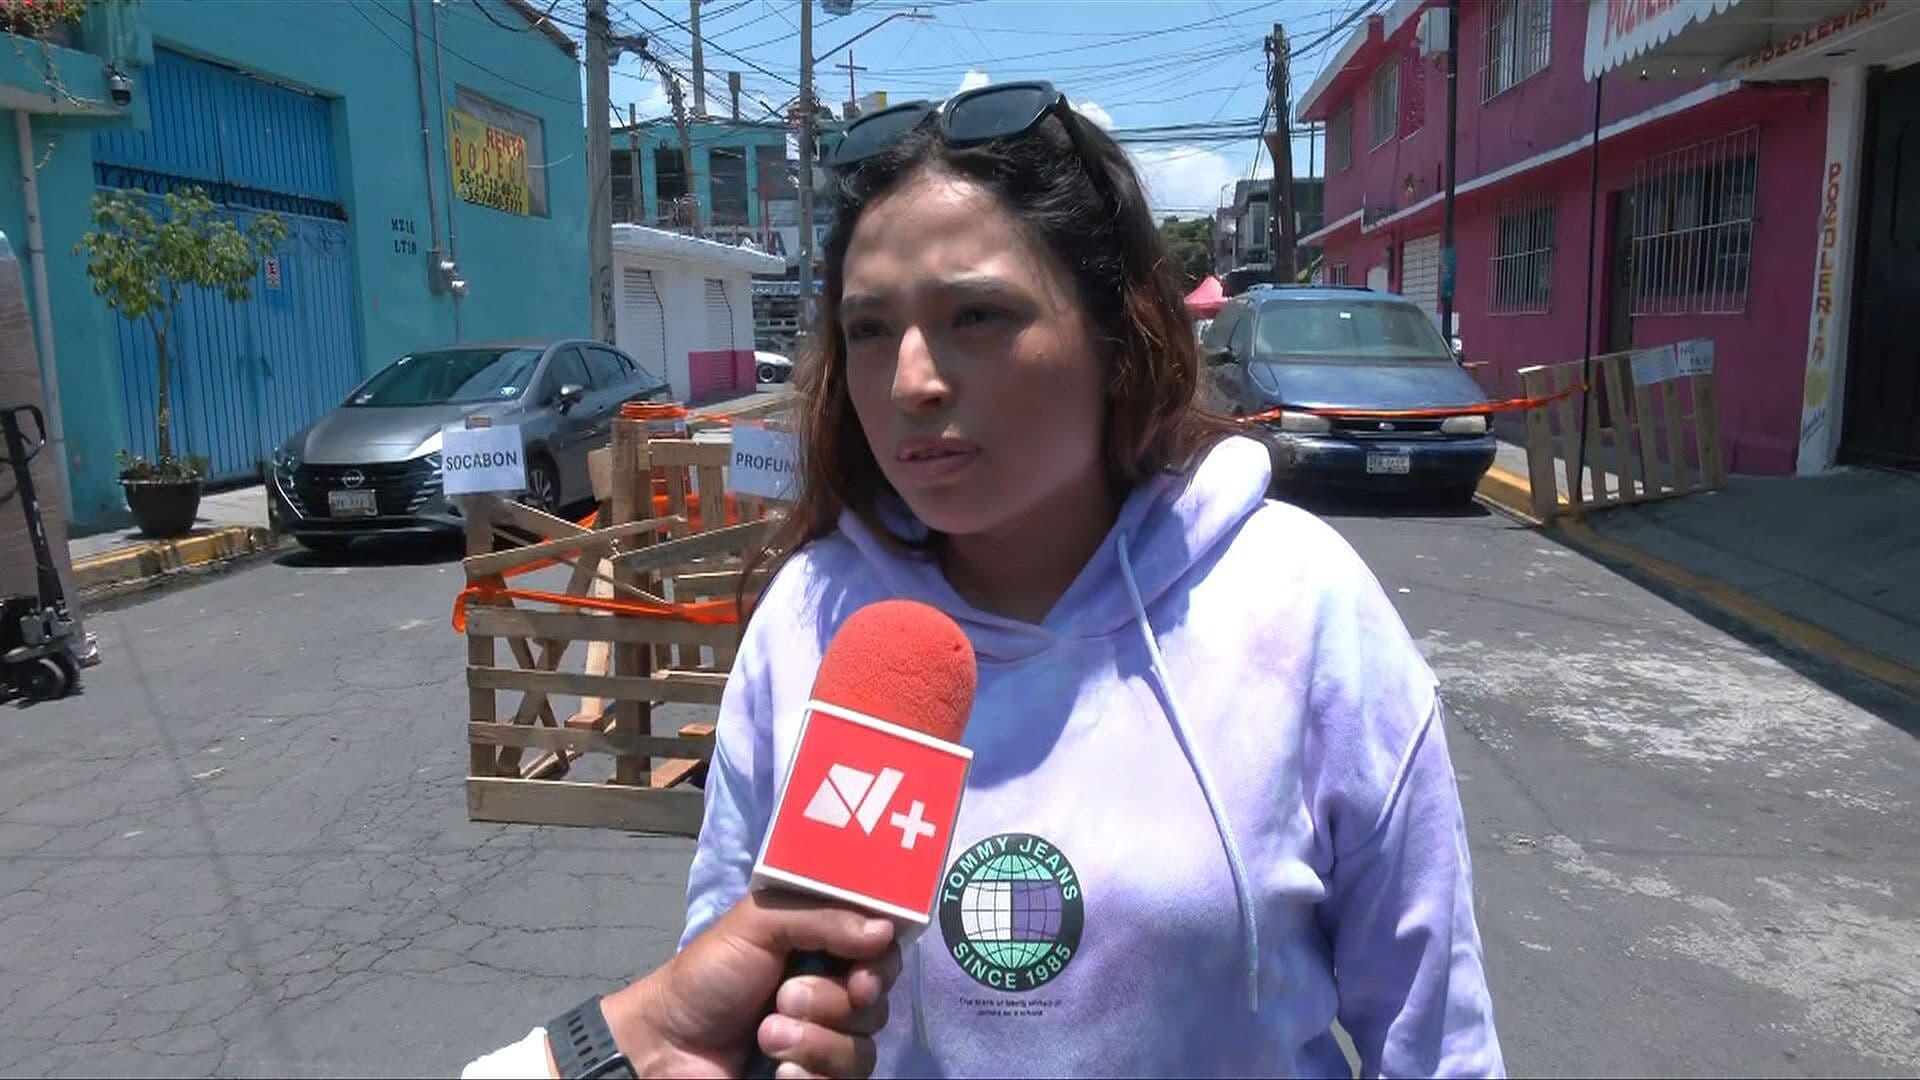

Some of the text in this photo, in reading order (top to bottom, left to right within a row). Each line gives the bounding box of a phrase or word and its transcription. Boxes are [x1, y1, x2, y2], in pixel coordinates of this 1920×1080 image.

[1813, 162, 1842, 364] POZOLERIA
[446, 450, 517, 471] SOCABON
[944, 836, 1078, 903] TOMMY JEANS
[953, 943, 1071, 989] SINCE 1985
